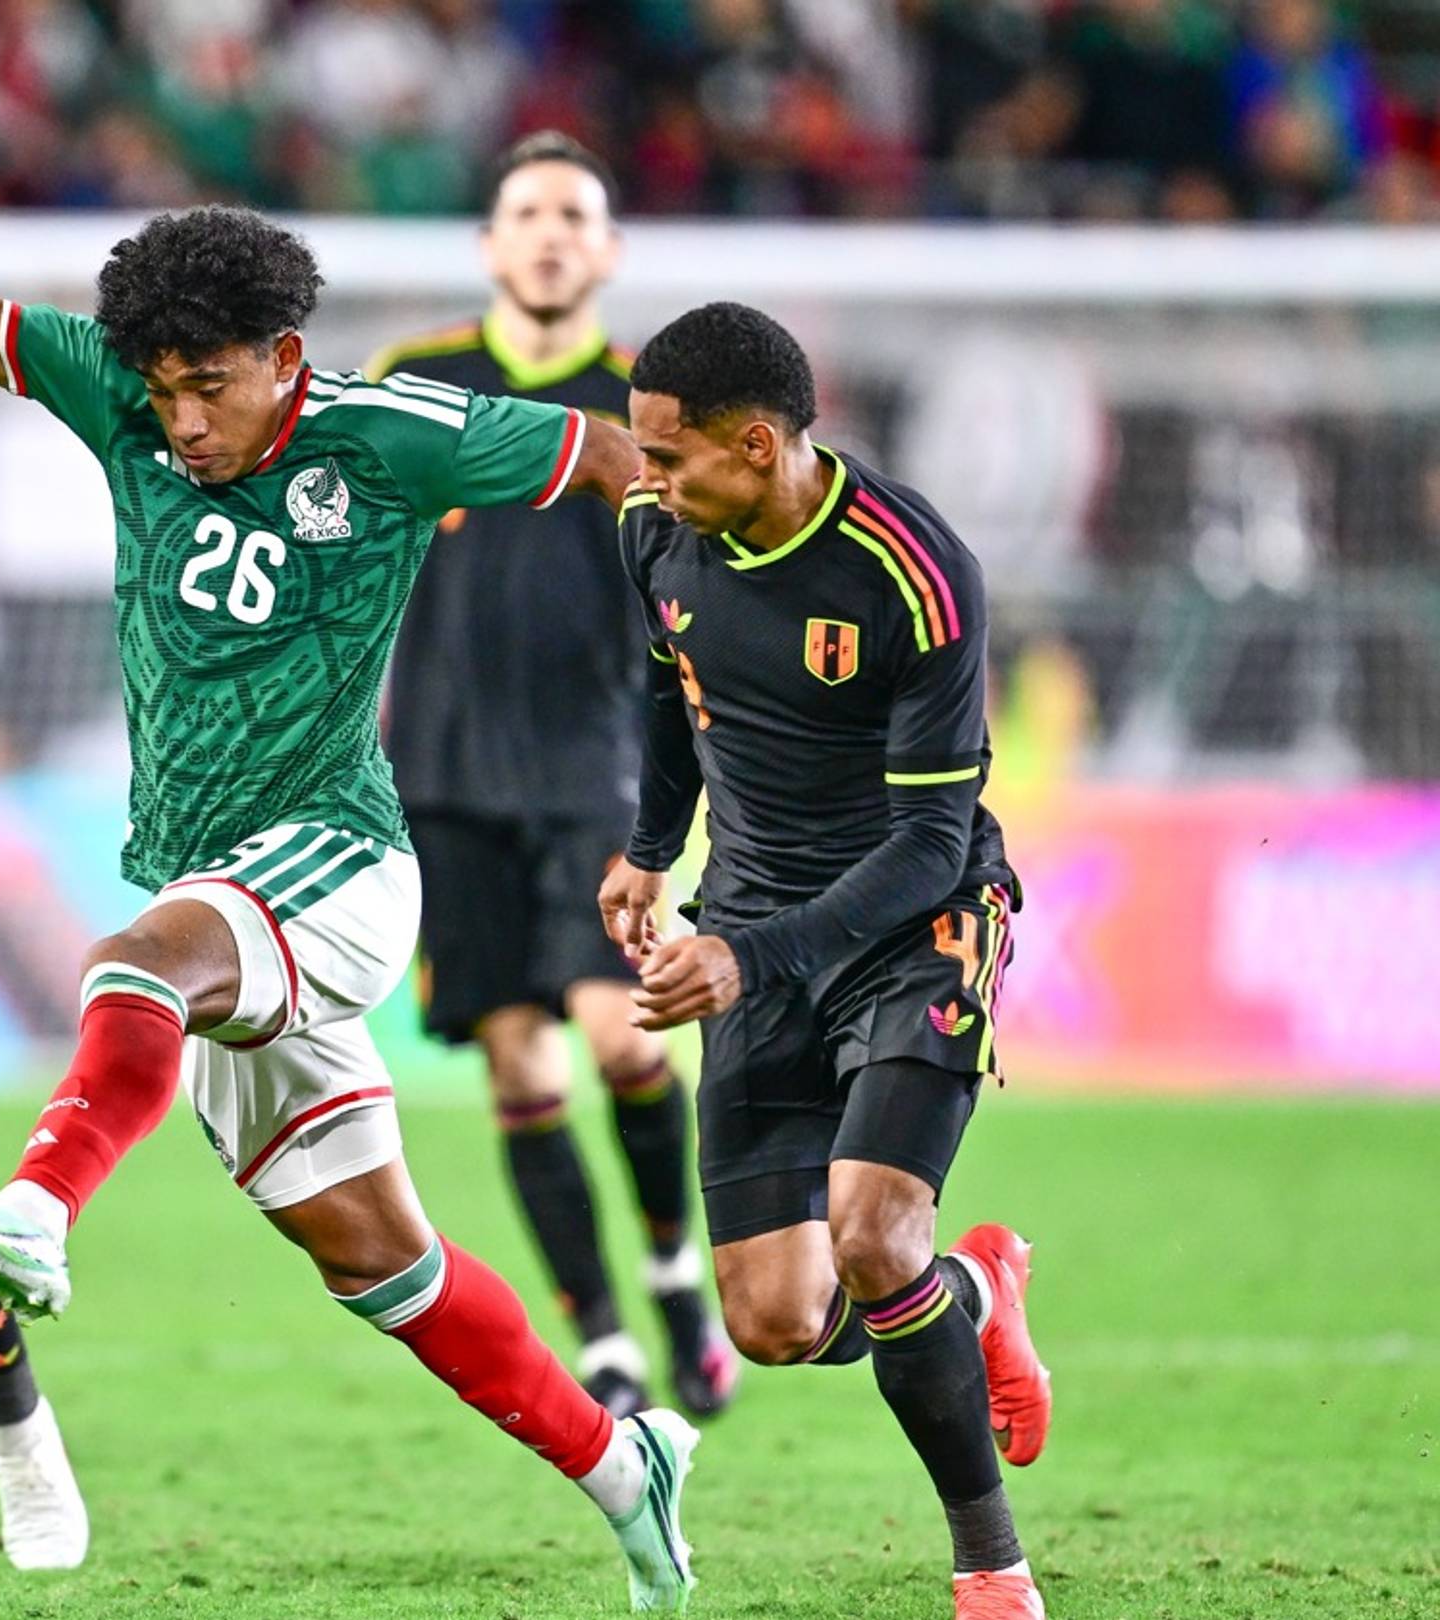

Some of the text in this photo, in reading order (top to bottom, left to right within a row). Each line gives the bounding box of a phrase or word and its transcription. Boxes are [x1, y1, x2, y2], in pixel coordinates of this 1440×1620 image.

[179, 513, 287, 625] 26
[295, 524, 350, 540] MEXICO
[931, 910, 981, 991] 4
